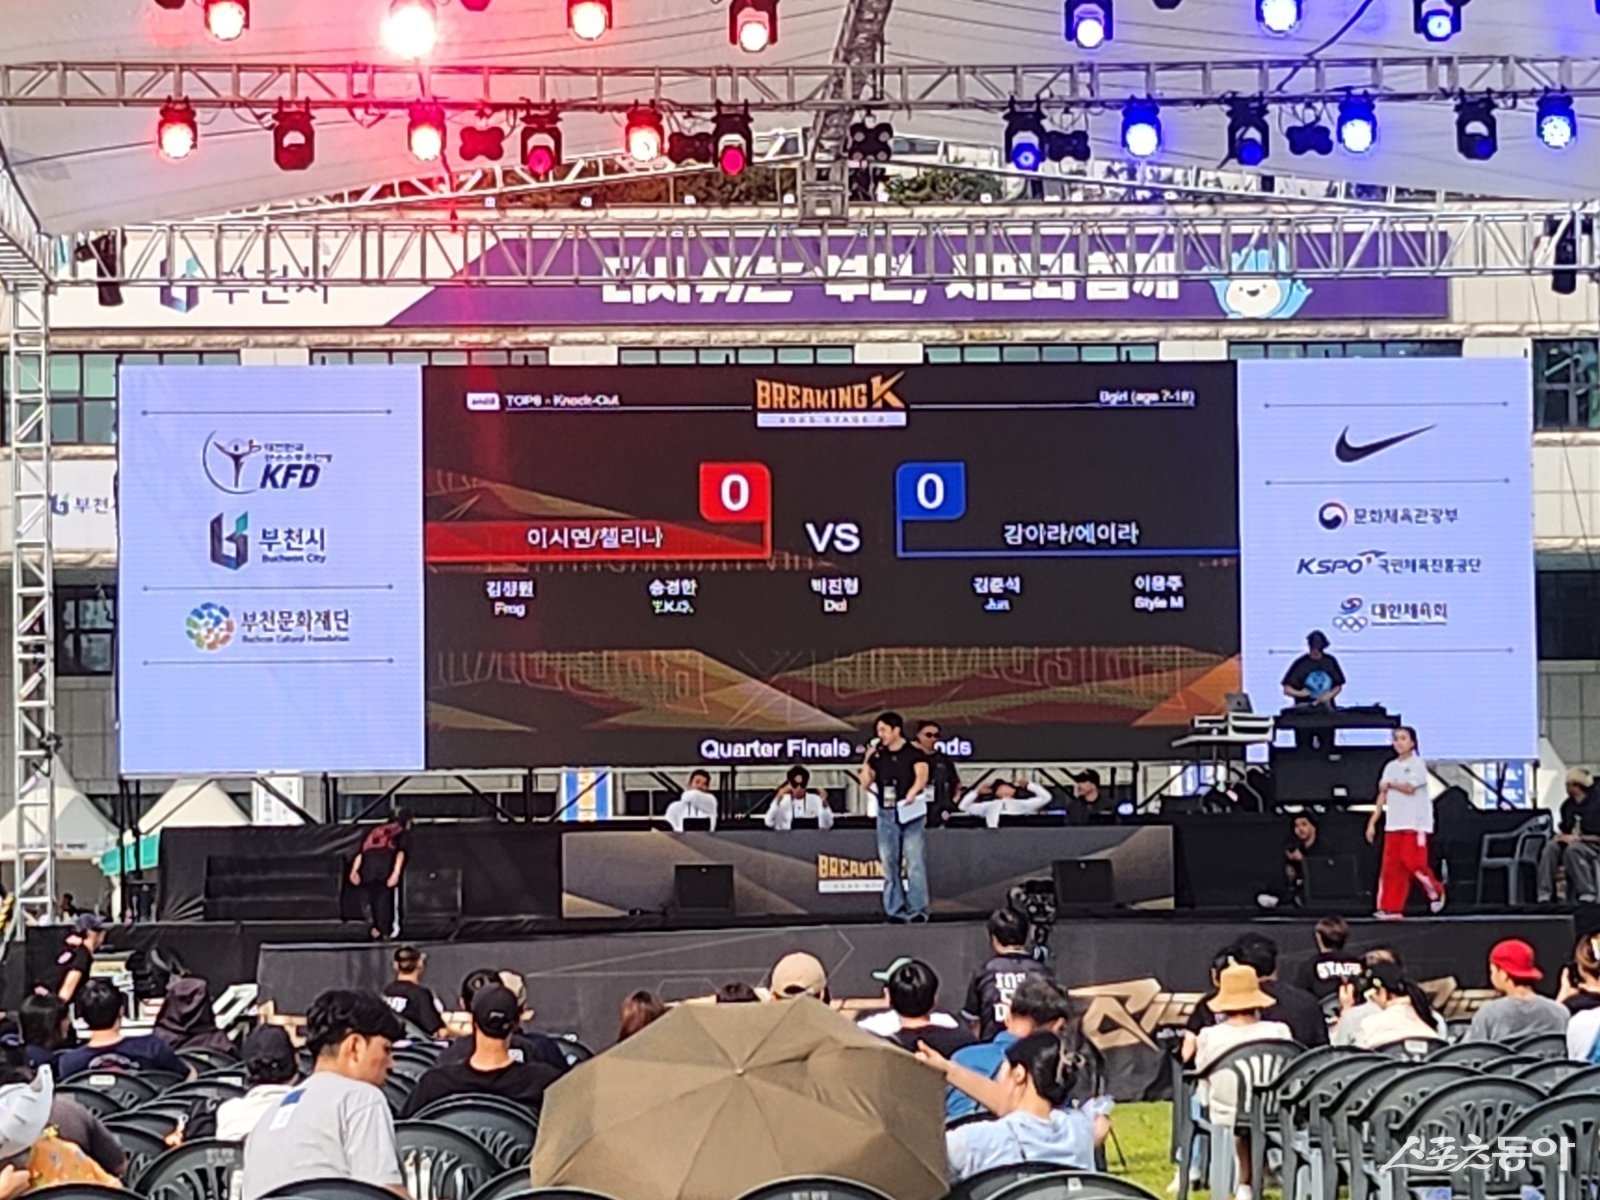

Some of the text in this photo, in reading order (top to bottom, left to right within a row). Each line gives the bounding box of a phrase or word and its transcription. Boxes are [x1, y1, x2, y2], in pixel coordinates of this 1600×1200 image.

[755, 370, 905, 409] BREAKING K
[260, 463, 321, 489] KFD
[720, 473, 750, 512] 0
[916, 472, 945, 509] 0
[1353, 507, 1459, 525] 문화체육관광부
[258, 527, 325, 552] 부천시
[804, 522, 861, 552] VS
[1296, 558, 1364, 575] KSPO
[241, 609, 349, 632] 부천문화재단
[1371, 602, 1447, 619] 대한체육회
[700, 738, 783, 759] Quarter
[786, 737, 851, 758] Finals
[818, 854, 886, 878] BREAKIN
